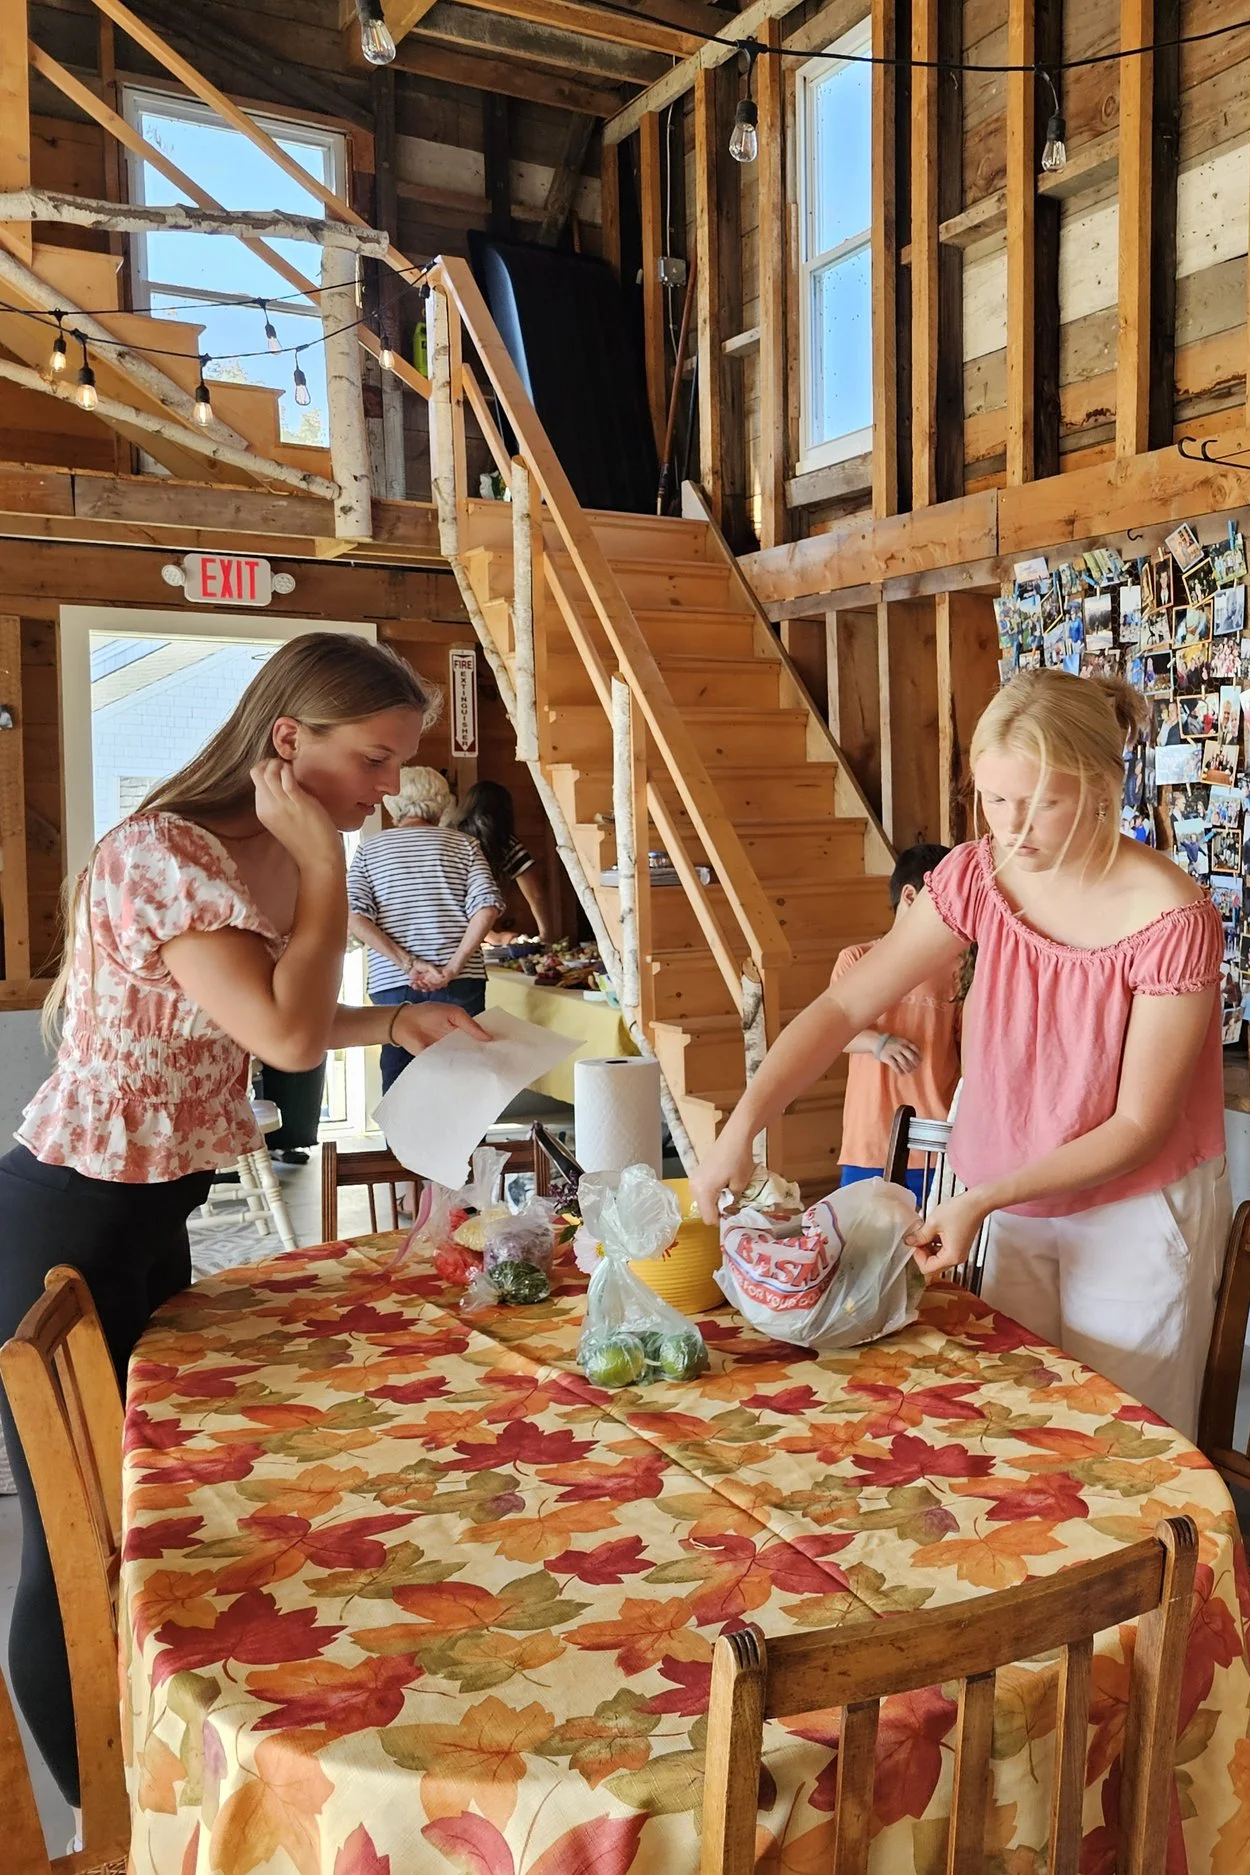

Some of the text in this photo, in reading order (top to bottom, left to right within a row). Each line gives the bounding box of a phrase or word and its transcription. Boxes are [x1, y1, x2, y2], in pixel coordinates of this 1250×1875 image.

[201, 557, 259, 600] EXIT
[454, 659, 472, 670] FIRE
[460, 671, 468, 747] EXTINGUISHER
[743, 1284, 765, 1301] FOR
